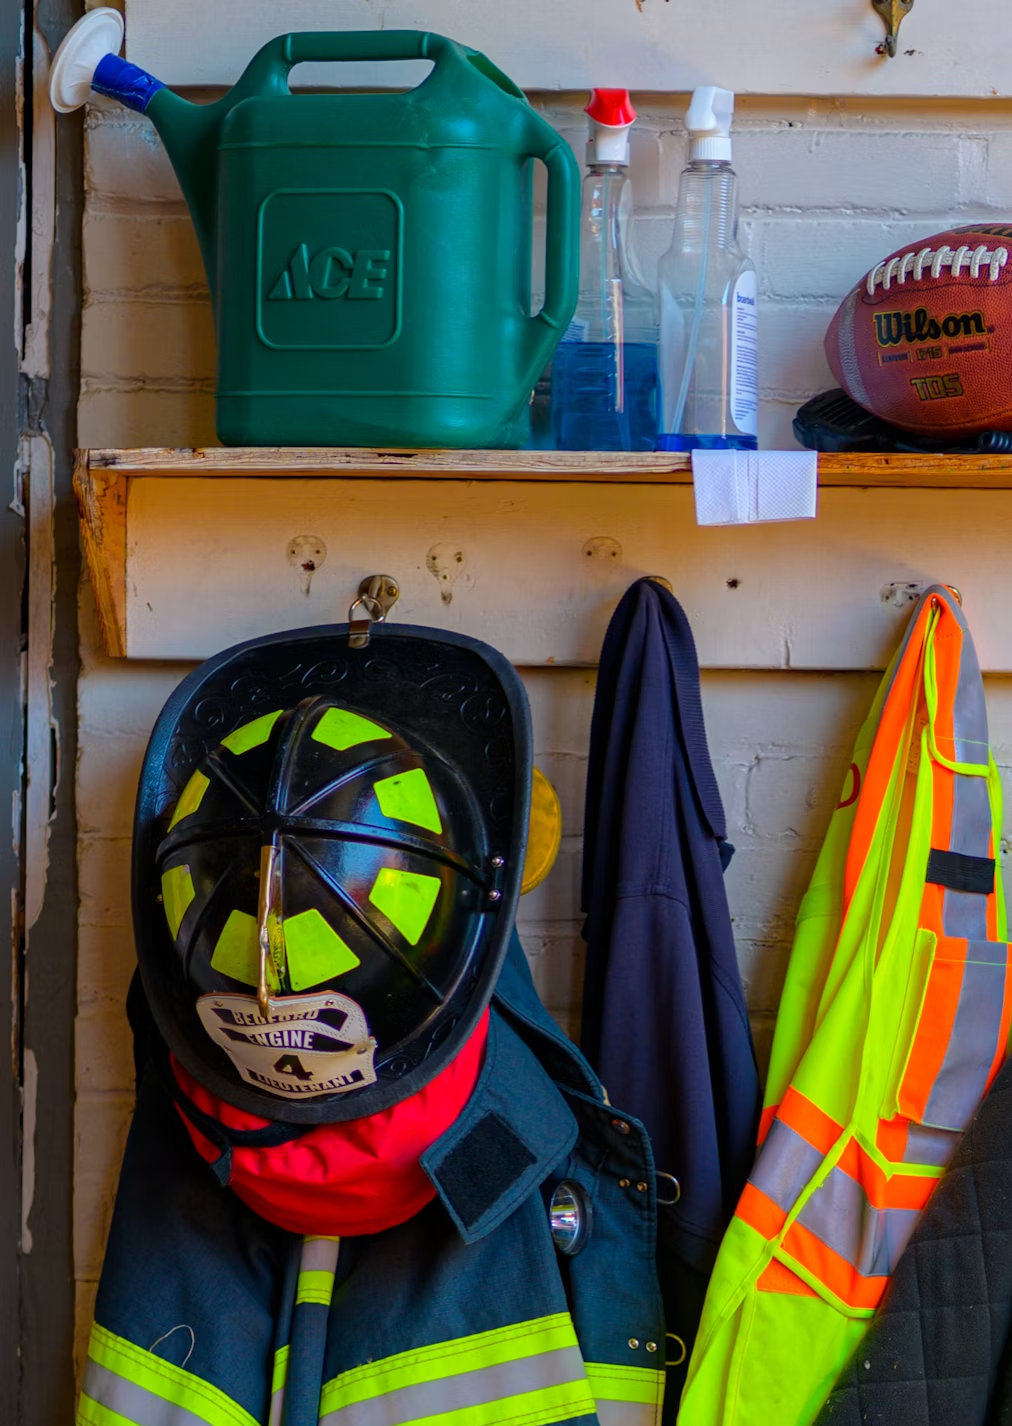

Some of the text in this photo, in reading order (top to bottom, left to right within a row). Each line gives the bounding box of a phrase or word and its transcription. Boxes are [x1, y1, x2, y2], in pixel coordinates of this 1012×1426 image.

[267, 243, 391, 300] ACE
[873, 306, 988, 348] Wilson
[911, 373, 965, 401] TDS
[232, 1010, 319, 1026] BEDFORD
[247, 1030, 315, 1050] ENGINE
[273, 1054, 314, 1081] 4
[257, 1071, 356, 1093] LIEUTENANT
